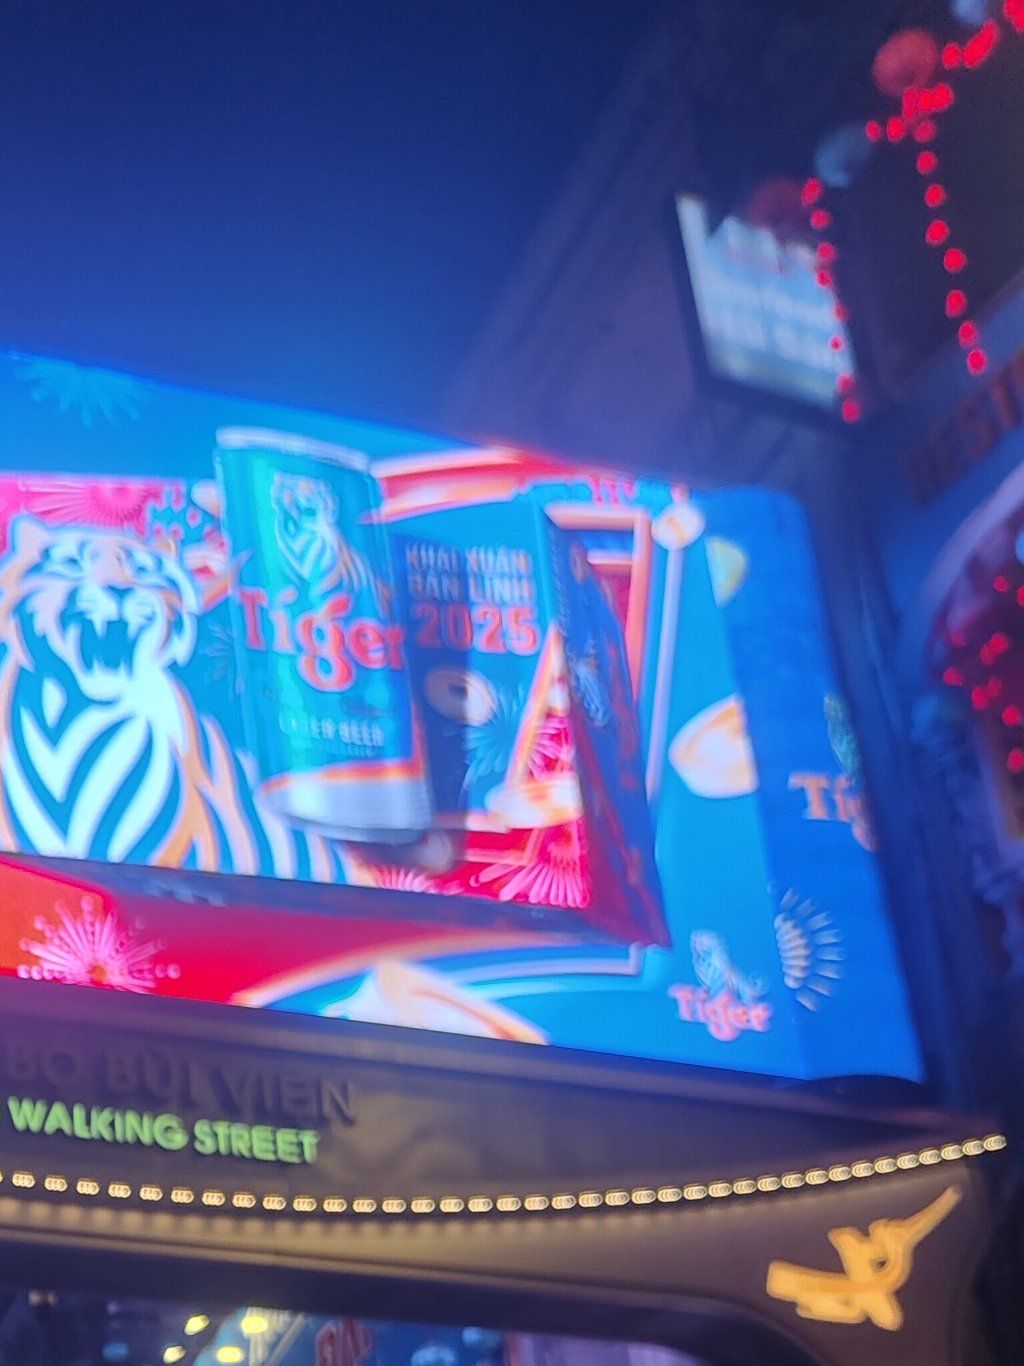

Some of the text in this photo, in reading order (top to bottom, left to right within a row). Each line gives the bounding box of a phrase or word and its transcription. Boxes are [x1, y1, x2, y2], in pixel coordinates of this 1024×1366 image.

[236, 586, 406, 692] Tiger
[413, 602, 542, 656] 2025
[667, 983, 774, 1042] Tiger
[7, 1096, 190, 1152] WALKING
[192, 1118, 320, 1164] STREET
